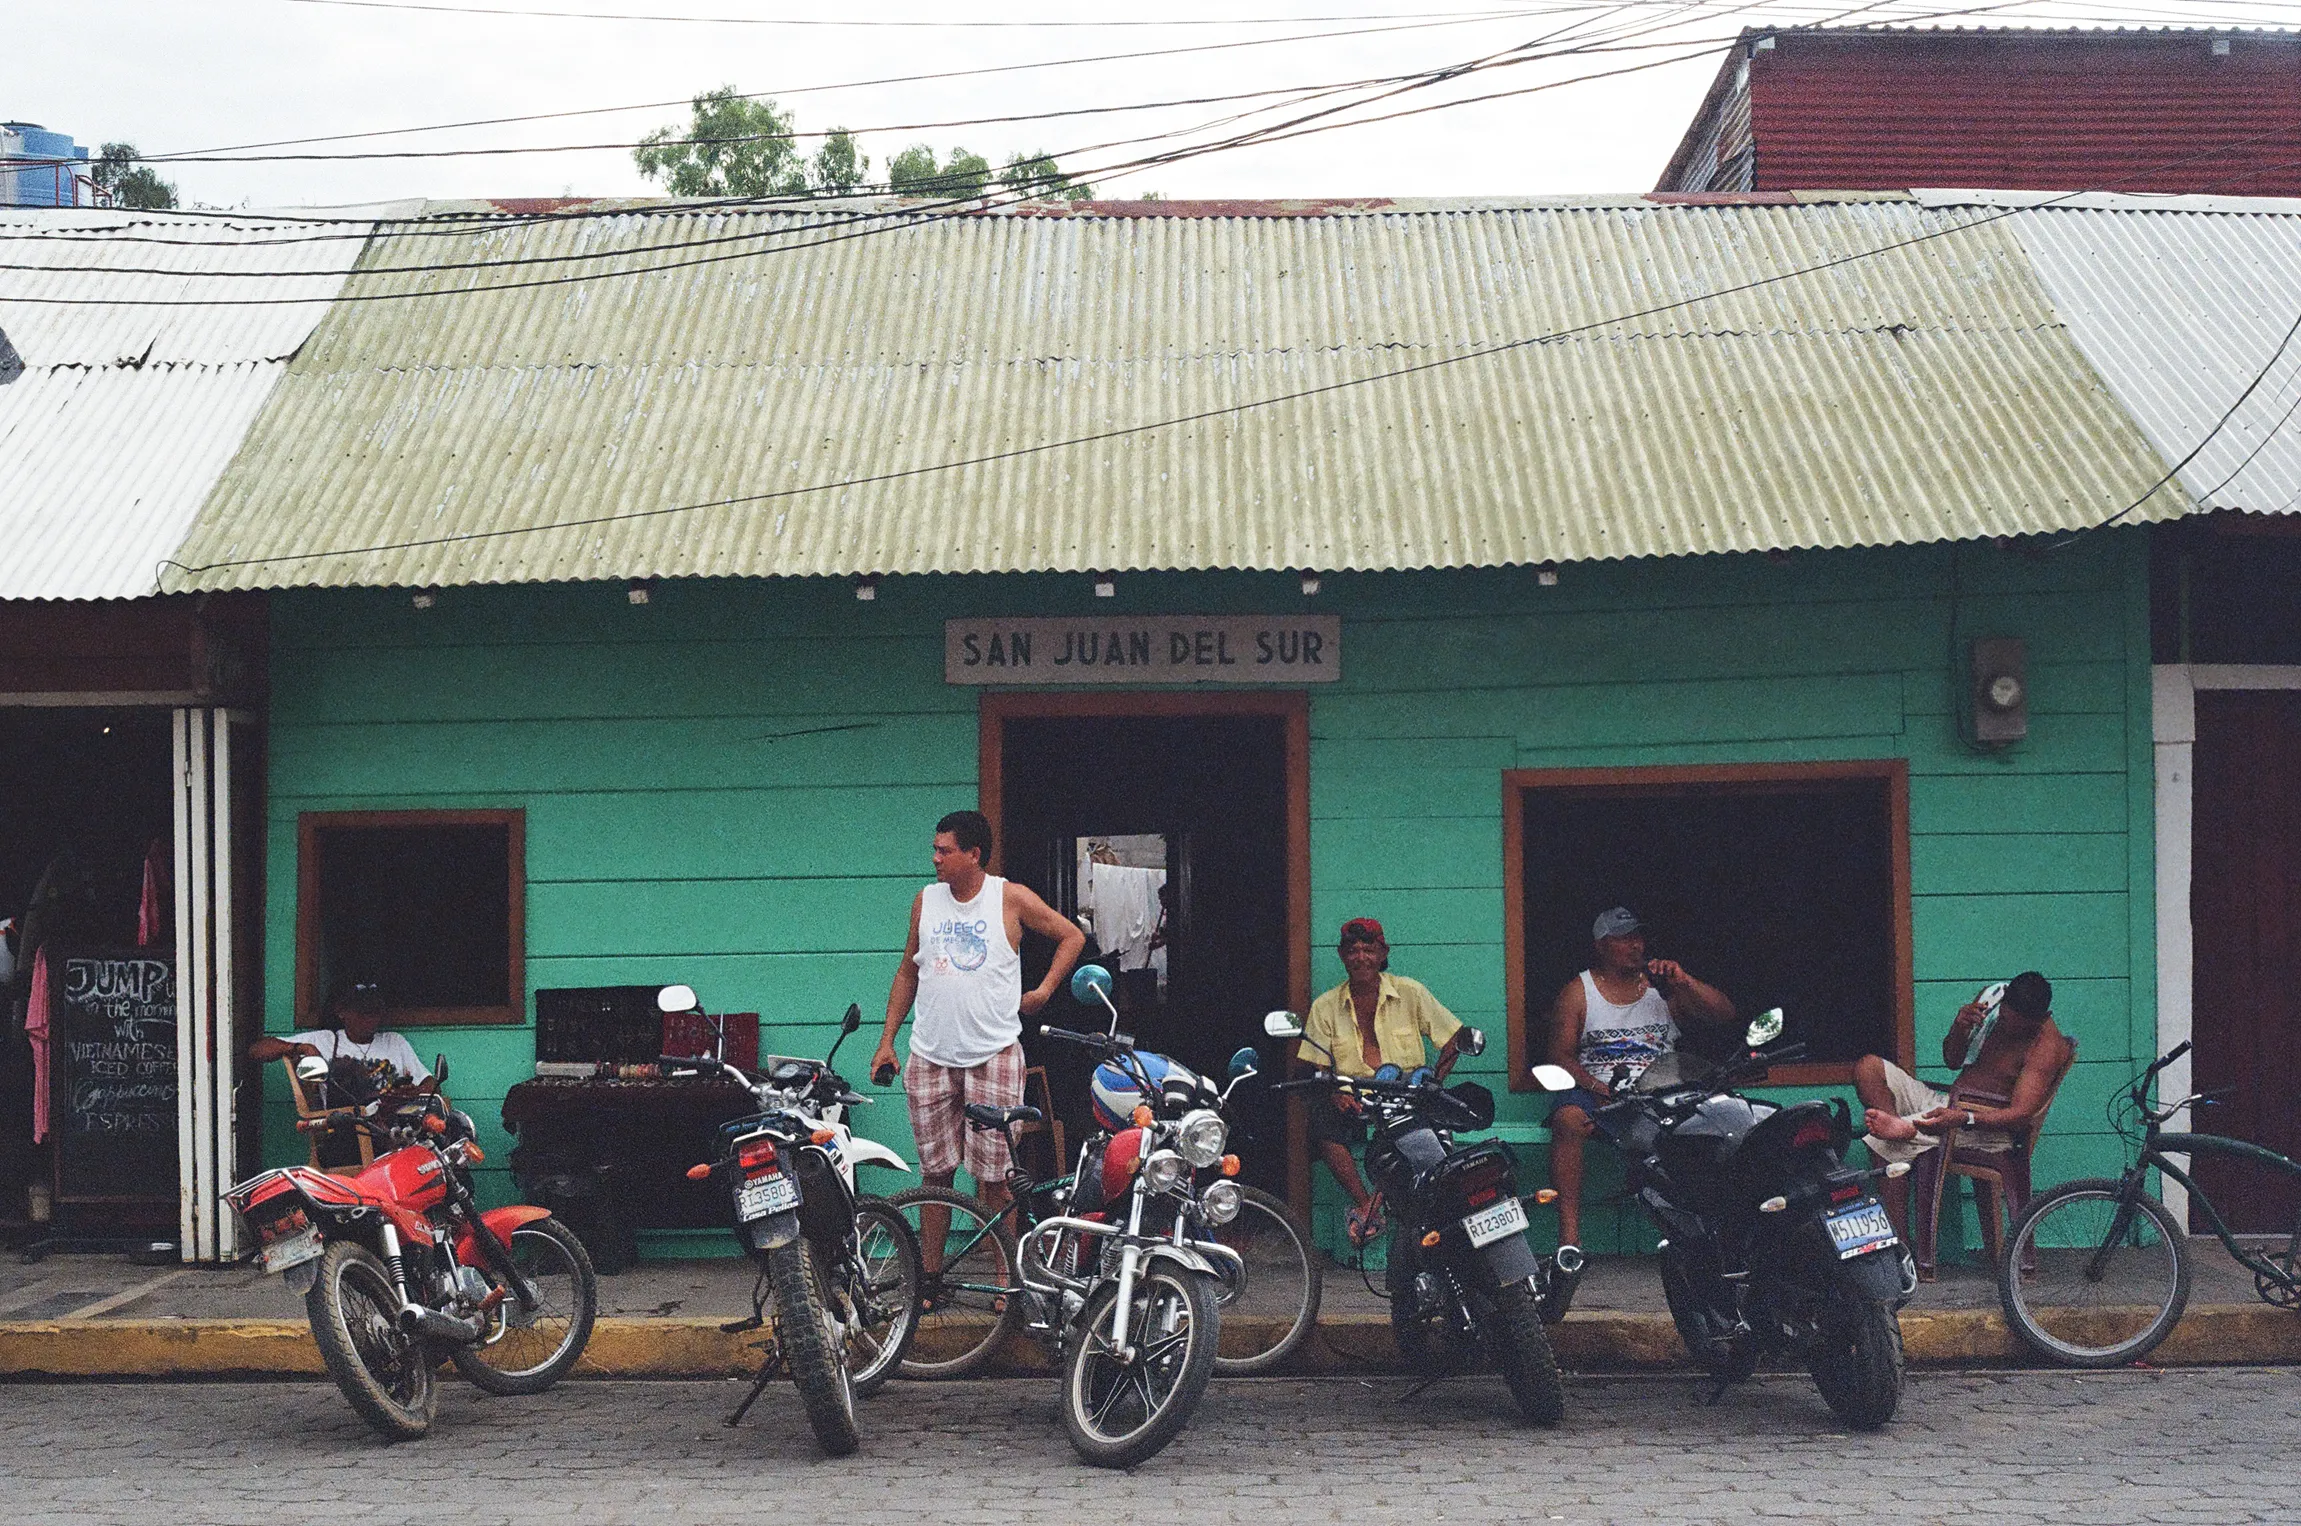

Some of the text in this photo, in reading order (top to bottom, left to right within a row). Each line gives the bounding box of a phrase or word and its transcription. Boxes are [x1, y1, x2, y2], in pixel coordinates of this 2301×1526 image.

[963, 630, 1323, 666] SAN JUAN DEL SUR
[933, 919, 987, 935] JUEGO
[65, 958, 177, 1004] JUMP u
[104, 998, 131, 1019] the
[134, 1002, 177, 1018] mornin
[114, 1015, 145, 1040] with
[69, 1042, 177, 1062] VIETNAMESE
[91, 1060, 129, 1076] ICED
[752, 1171, 784, 1186] YAMAHA
[739, 1181, 796, 1209] RI35803
[743, 1210, 767, 1222] Casa
